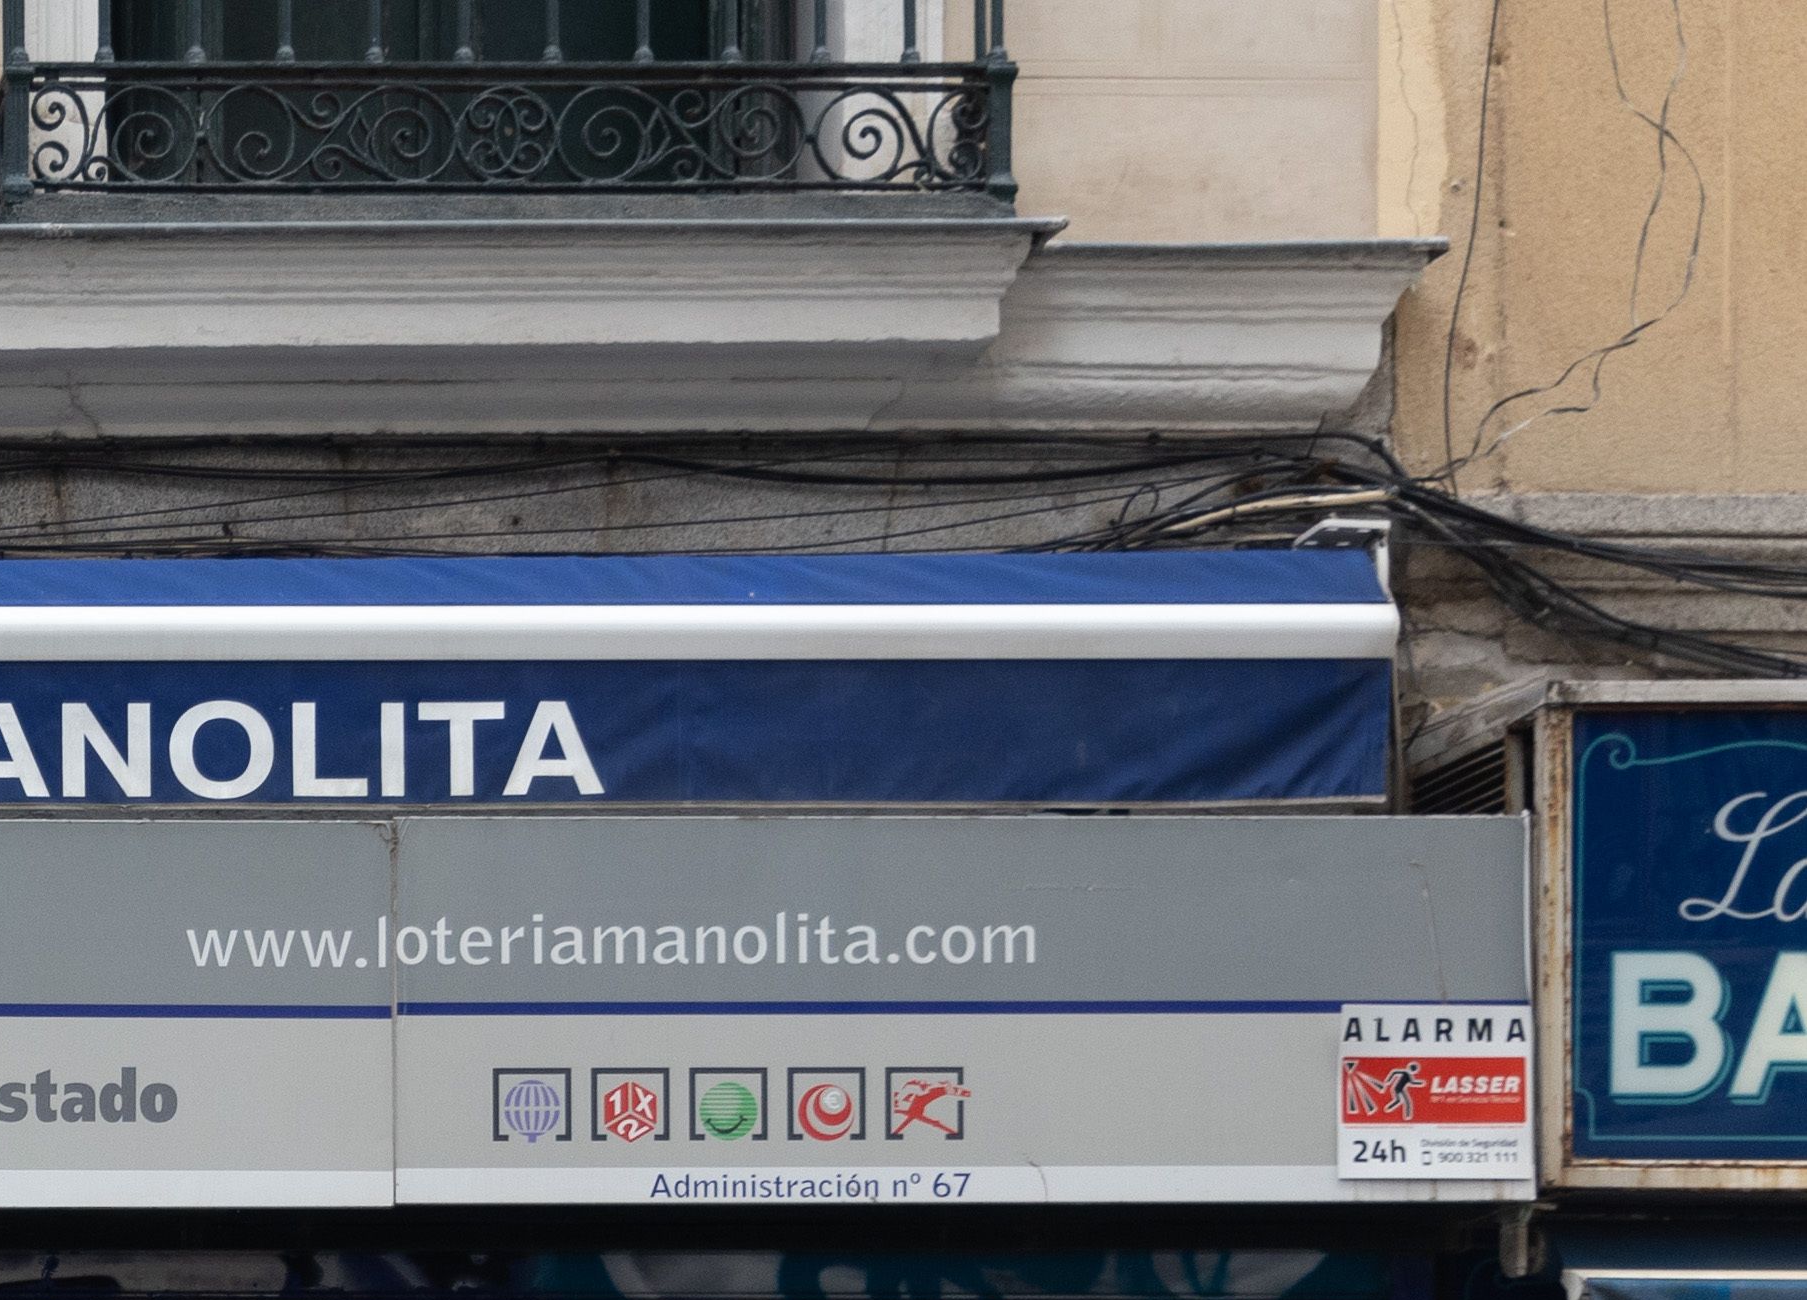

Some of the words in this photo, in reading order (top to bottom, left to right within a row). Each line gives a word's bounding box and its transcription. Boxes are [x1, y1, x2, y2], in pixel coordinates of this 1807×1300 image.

[185, 908, 1039, 972] www.loteriamanolita.com
[1343, 1017, 1526, 1042] ALARMA
[1430, 1076, 1521, 1094] LASSER
[1353, 1139, 1406, 1163] 24h
[650, 1173, 881, 1200] Administración
[932, 1173, 972, 1199] 67
